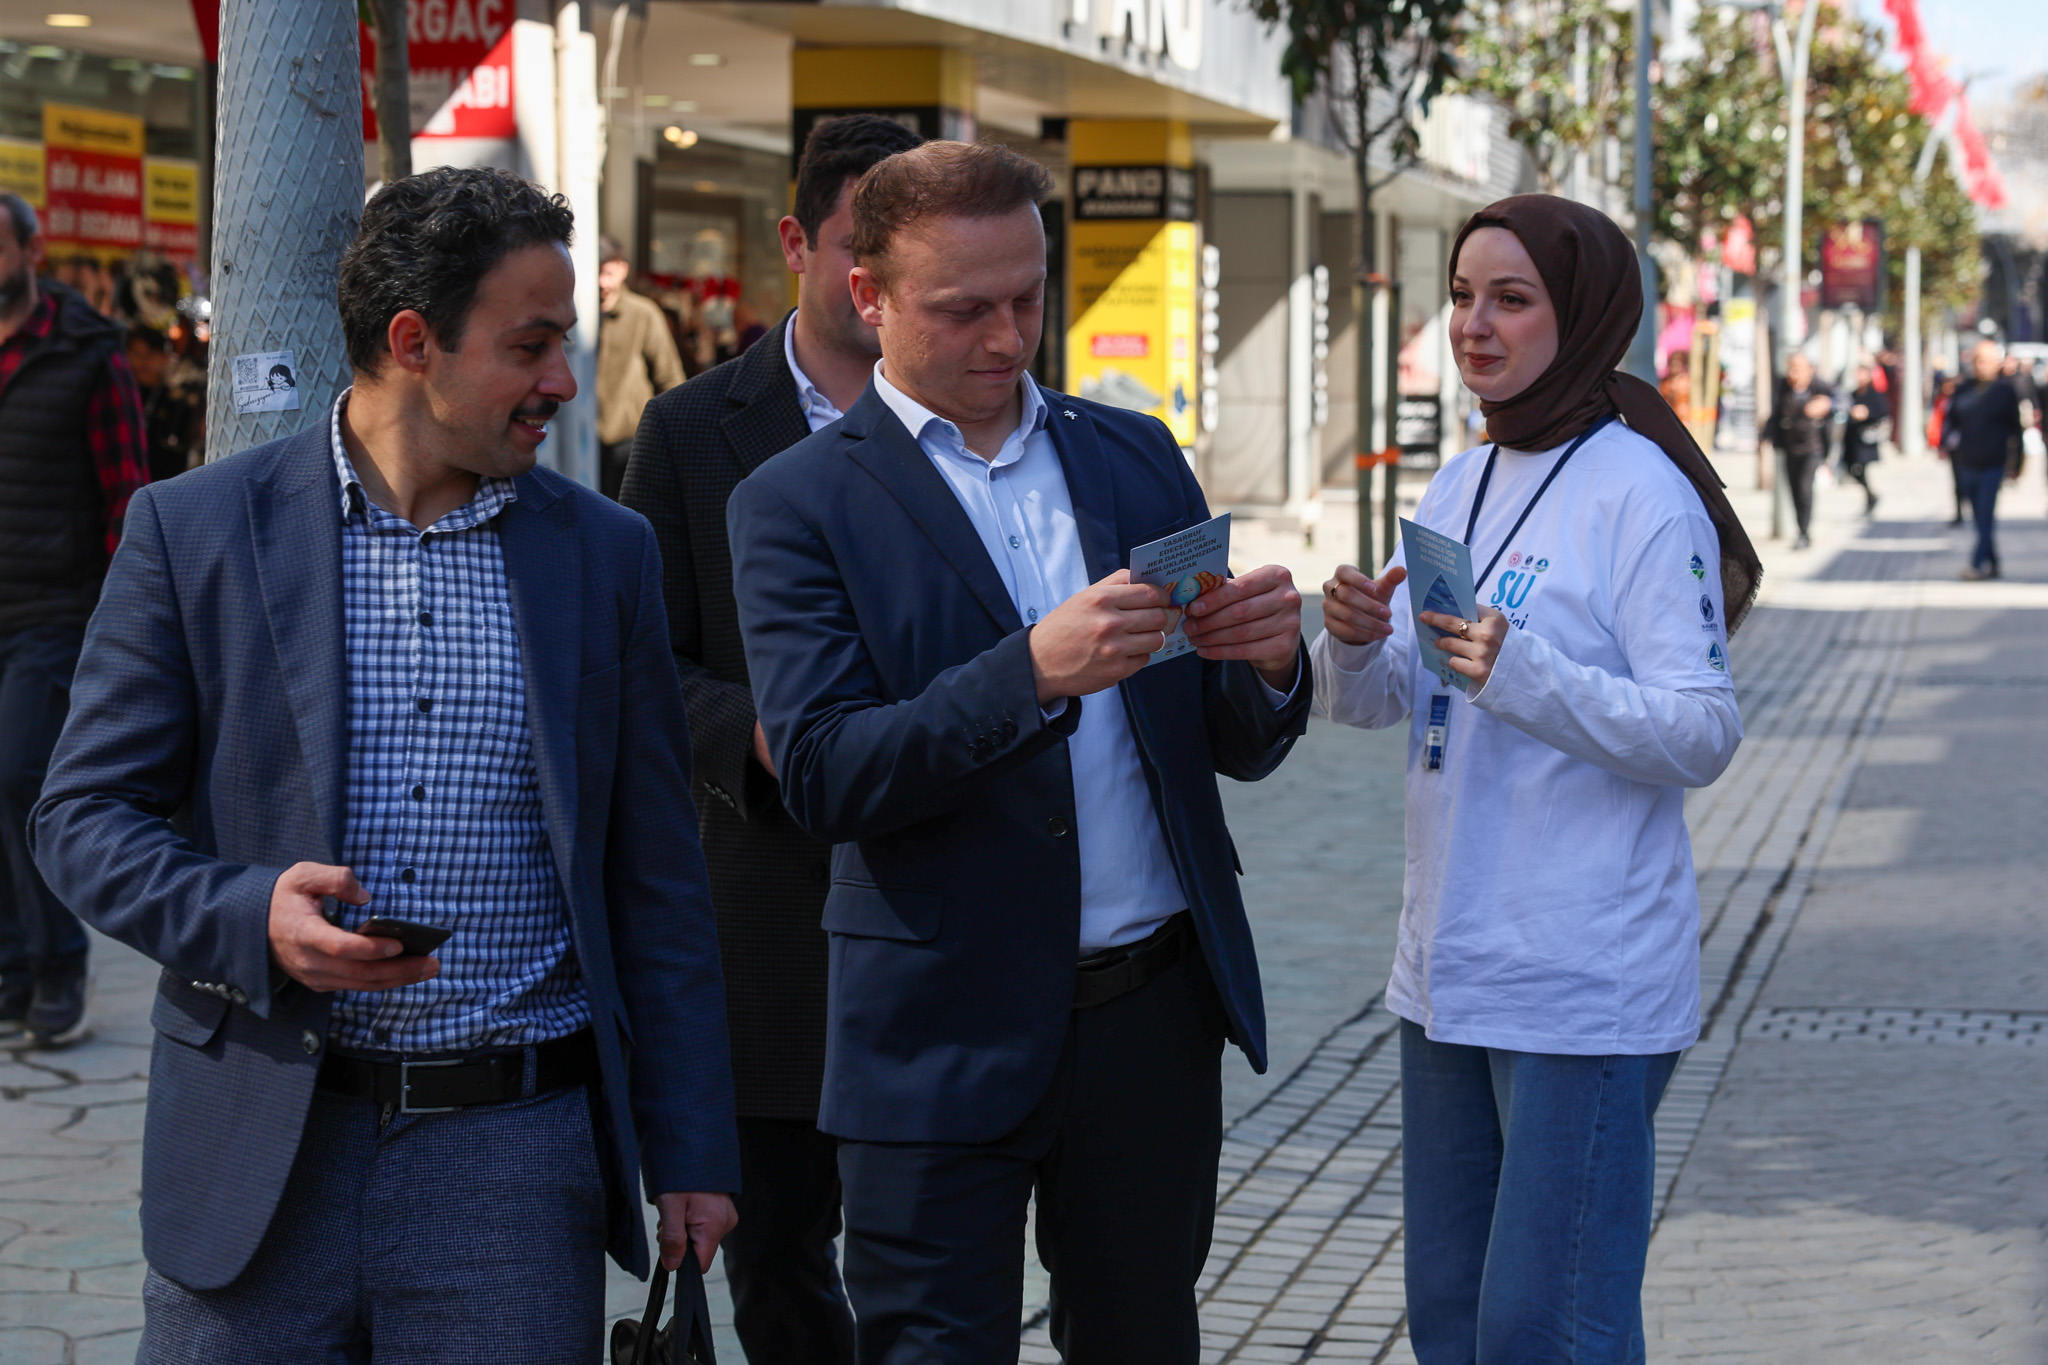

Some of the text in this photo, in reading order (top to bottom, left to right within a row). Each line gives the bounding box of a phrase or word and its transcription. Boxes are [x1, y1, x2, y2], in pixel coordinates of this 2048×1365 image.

[1076, 169, 1163, 198] PANO
[1147, 537, 1217, 568] HER DAMLA YARIN
[1159, 534, 1207, 557] EDECEĞİMİZ
[1163, 528, 1203, 548] TASARRUF
[1141, 543, 1222, 577] MUSLUKLARIMIZDAN
[1165, 560, 1198, 576] AKACAK
[1490, 570, 1536, 609] SU
